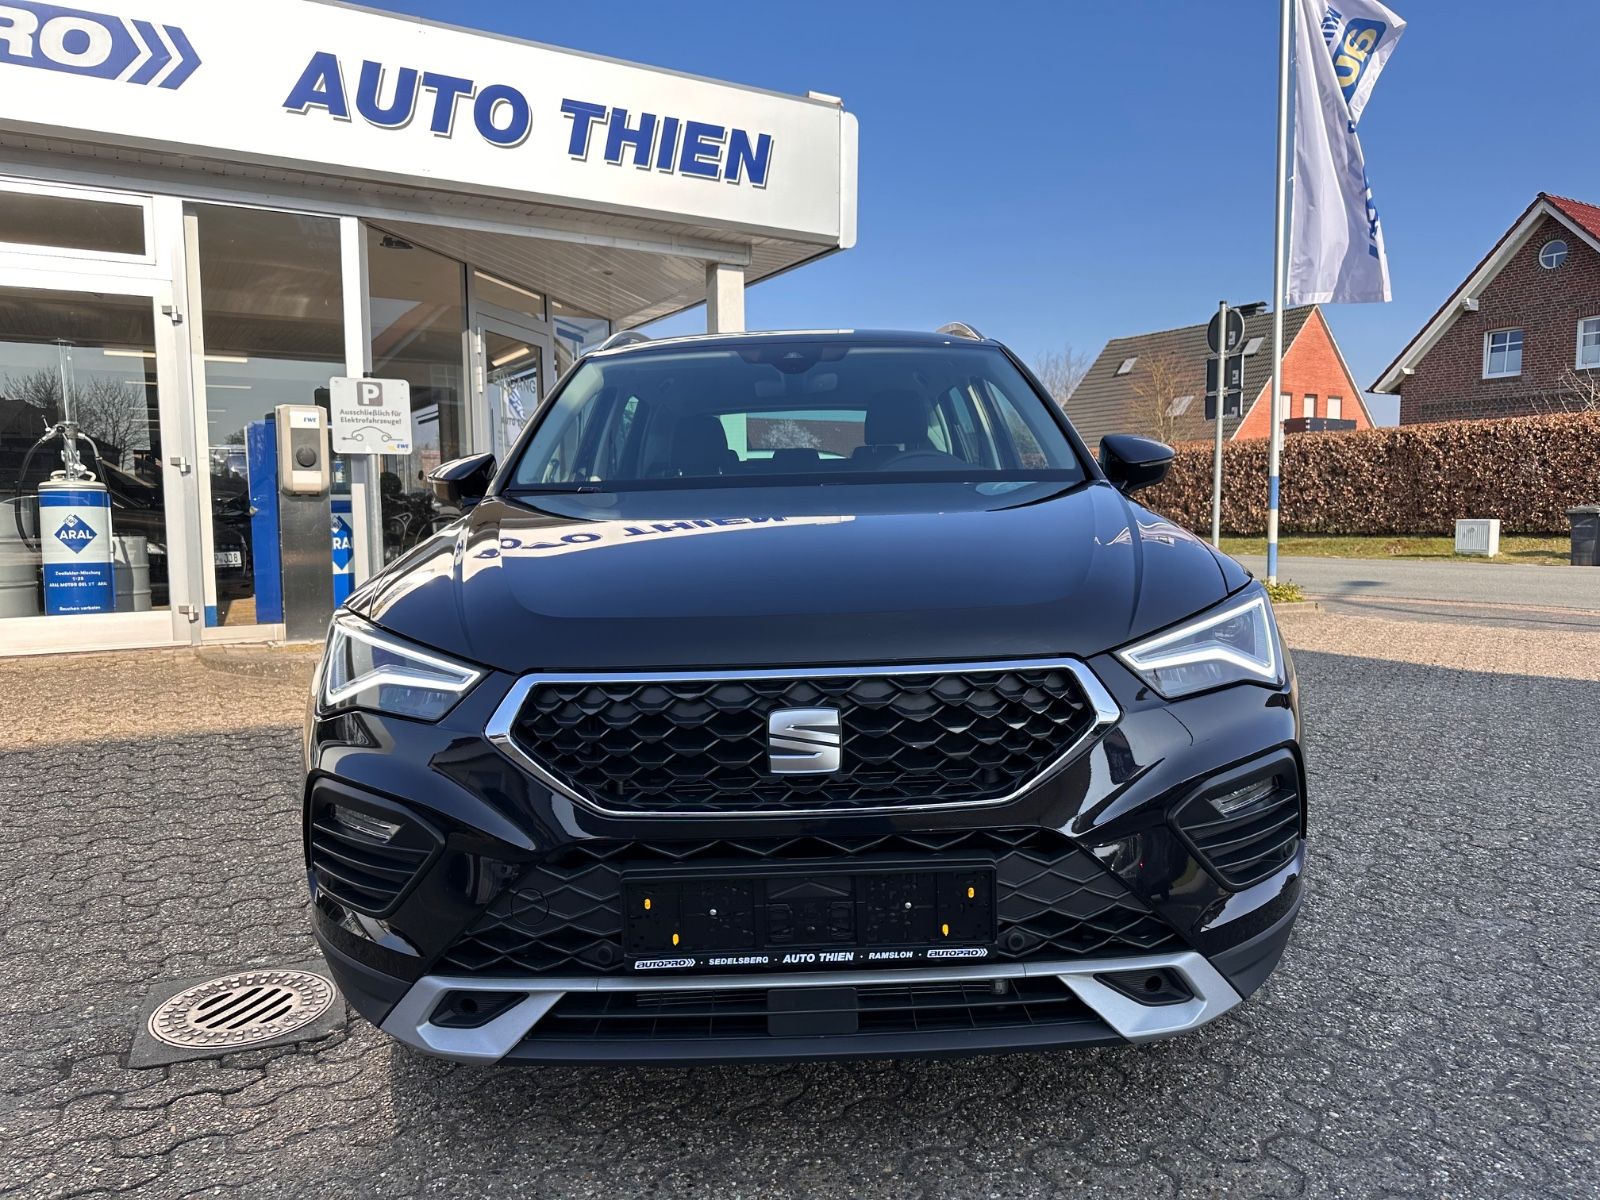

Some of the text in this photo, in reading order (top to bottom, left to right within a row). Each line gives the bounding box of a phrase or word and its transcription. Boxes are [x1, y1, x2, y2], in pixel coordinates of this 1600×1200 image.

[282, 50, 774, 188] AUTO THIEN
[362, 383, 380, 405] P
[340, 408, 402, 417] Ausschließlich für
[340, 416, 402, 425] Elektrofahrzeuge!
[60, 529, 93, 540] ARAL
[333, 536, 353, 550] RA
[708, 956, 769, 966] SEDELSBERG
[782, 953, 816, 964] AUTO
[818, 951, 854, 962] THIEN
[868, 951, 914, 960] RAMSLOH
